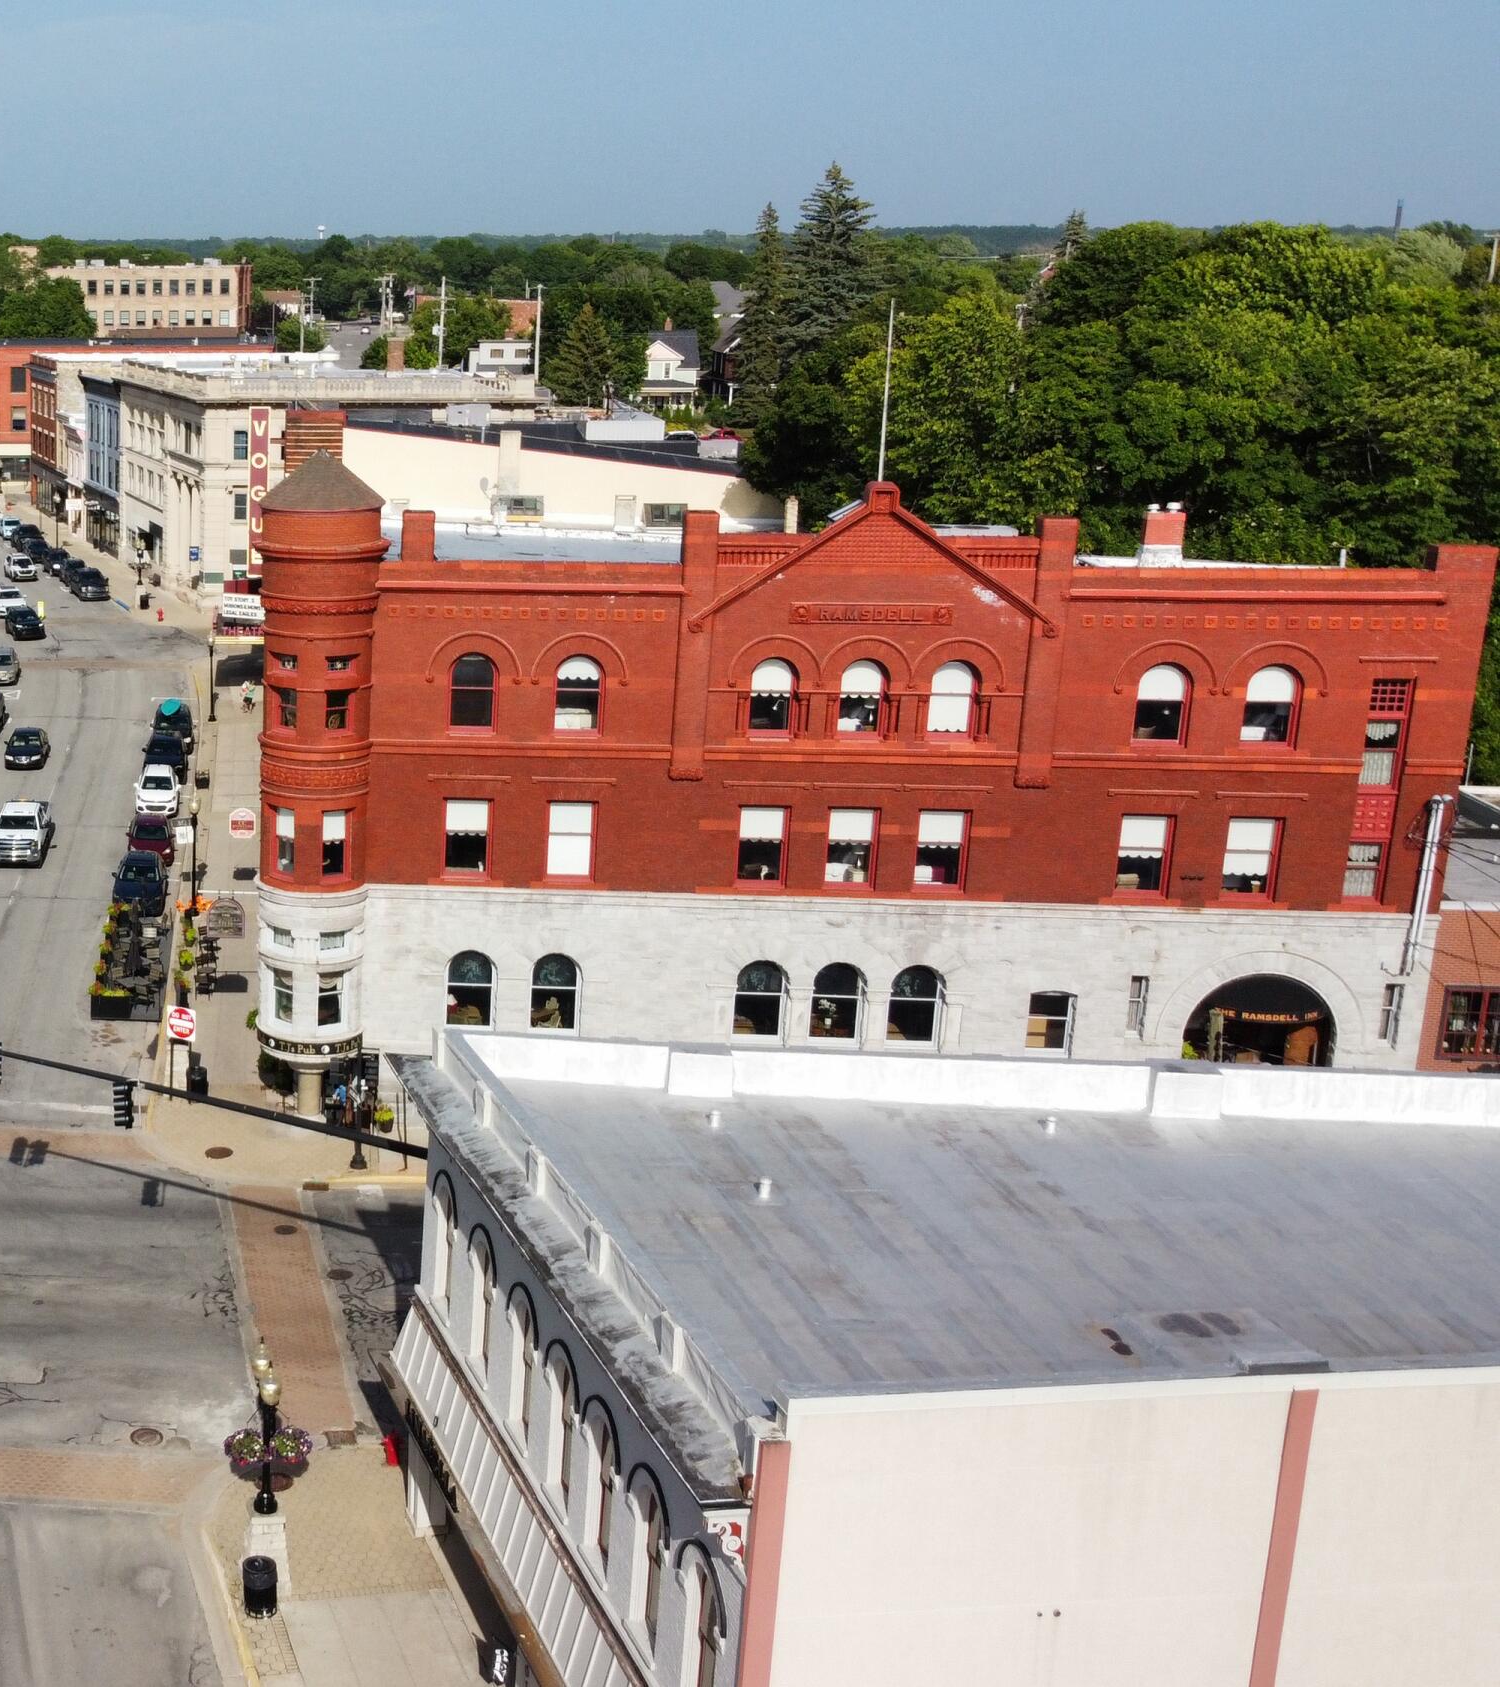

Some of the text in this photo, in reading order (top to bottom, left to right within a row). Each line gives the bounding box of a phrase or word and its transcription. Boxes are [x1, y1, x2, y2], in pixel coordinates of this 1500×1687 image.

[251, 420, 267, 564] VOGUE
[818, 606, 924, 622] RAMSDELL
[1241, 1011, 1300, 1021] RAMSDELL
[297, 1044, 316, 1054] Pub
